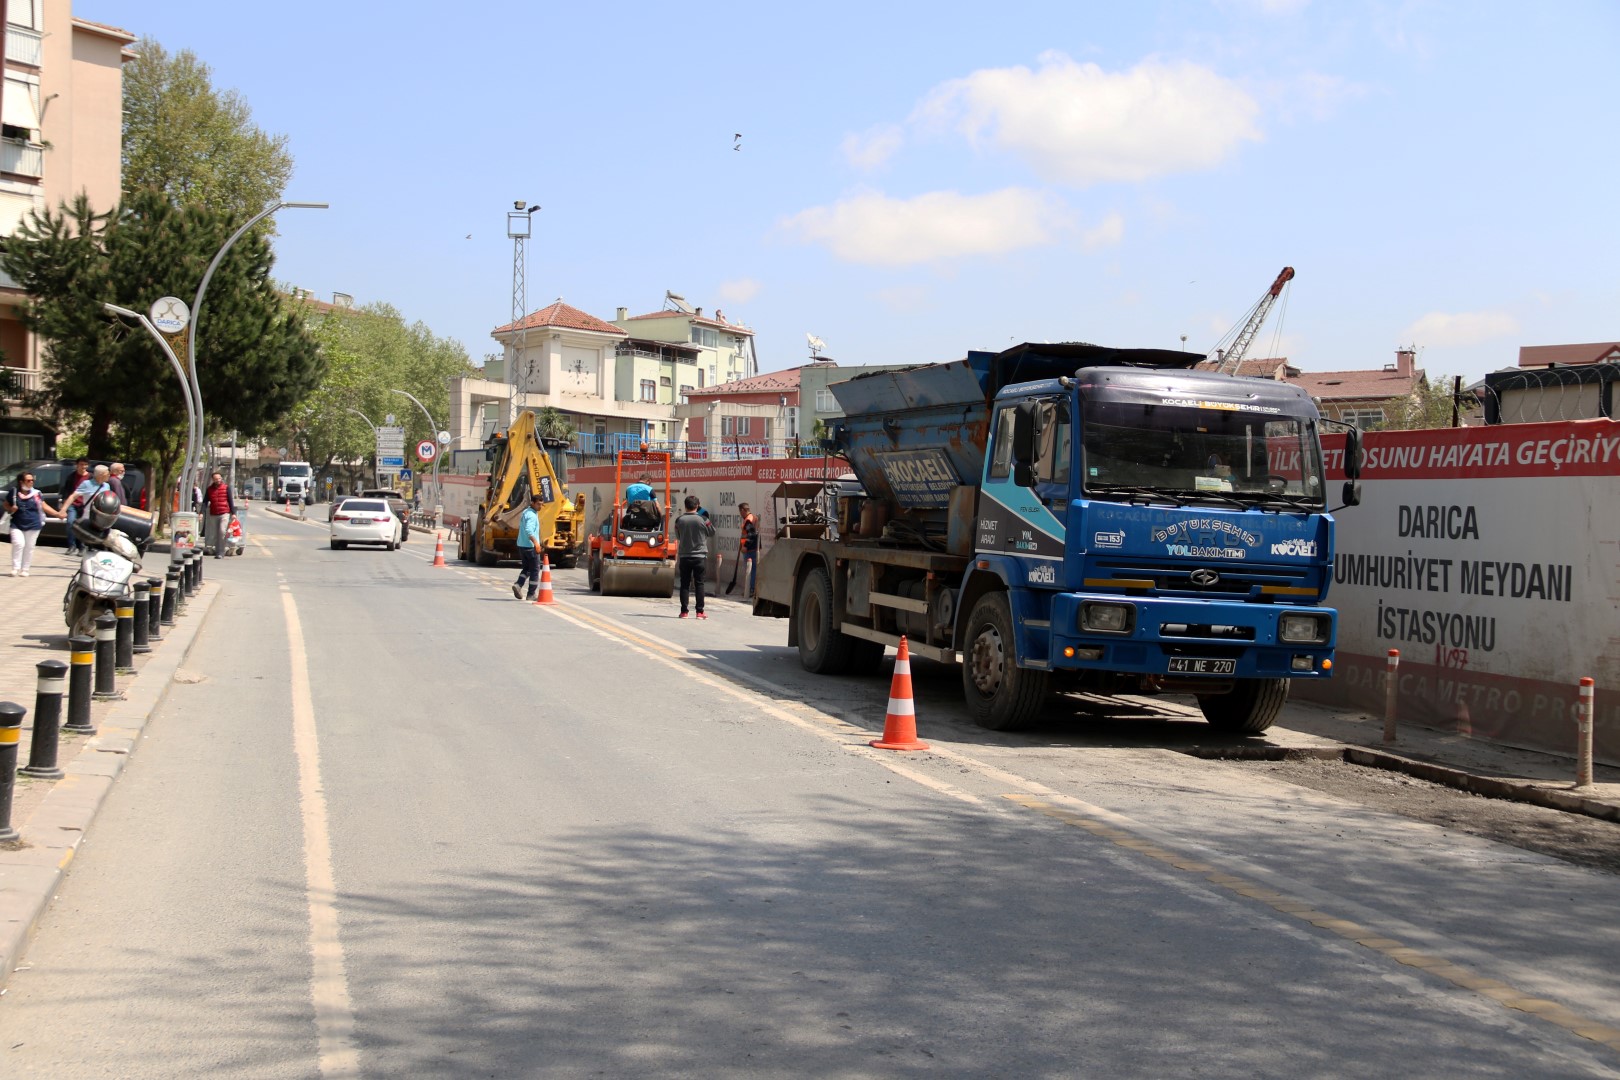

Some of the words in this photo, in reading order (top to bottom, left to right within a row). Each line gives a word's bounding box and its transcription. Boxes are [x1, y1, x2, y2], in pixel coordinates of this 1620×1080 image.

[1428, 442, 1510, 468] HAYATA
[1516, 432, 1620, 470] GEÇİRİY
[758, 468, 777, 479] GEBZE
[780, 468, 803, 479] DARICA
[1109, 535, 1121, 543] 153
[1398, 504, 1480, 540] DARICA
[1331, 550, 1453, 594] UMHURİYET
[1460, 559, 1573, 602] MEYDANI
[1377, 598, 1496, 652] İSTASYONU
[1177, 659, 1189, 671] 41
[1194, 660, 1207, 672] NE
[1213, 661, 1232, 673] 270
